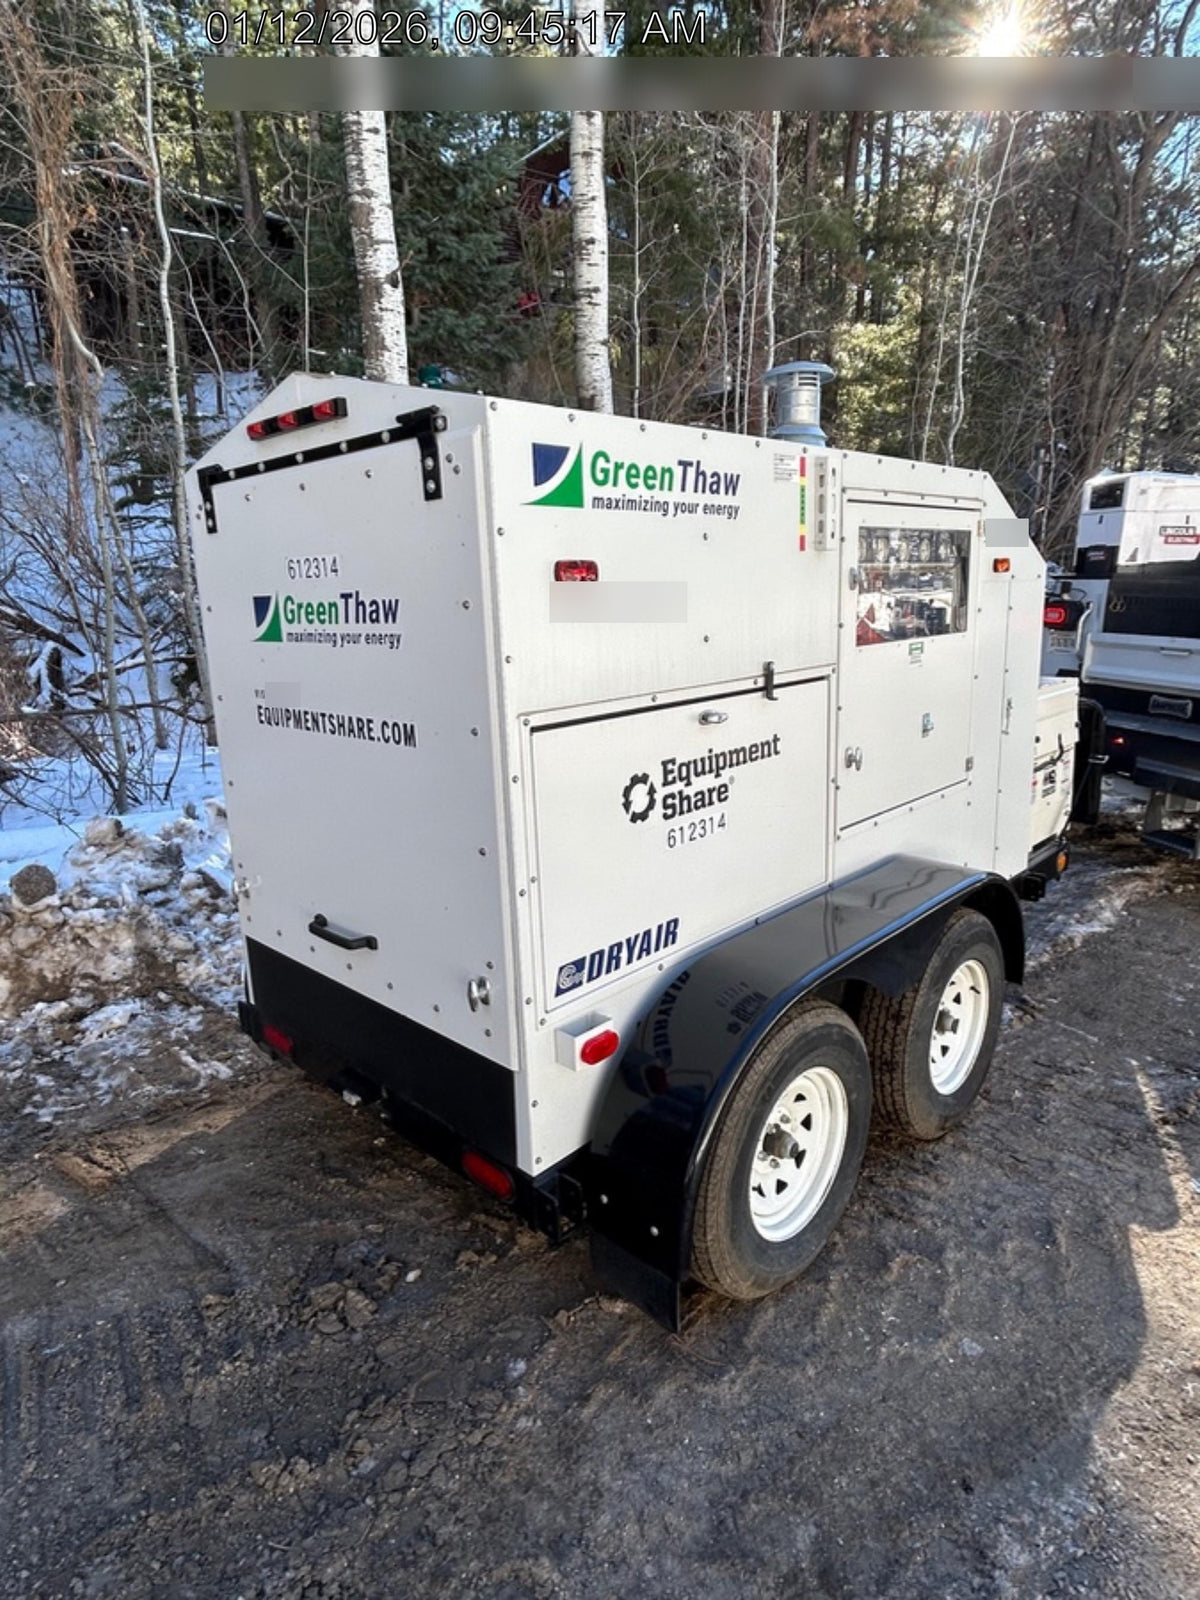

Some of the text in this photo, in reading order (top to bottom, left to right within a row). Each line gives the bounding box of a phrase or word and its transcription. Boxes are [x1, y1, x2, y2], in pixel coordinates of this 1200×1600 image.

[589, 449, 742, 497] GreenThaw
[591, 494, 740, 520] maximizing your energy
[287, 556, 339, 580] 612314
[283, 590, 400, 625] GreenThaw
[286, 627, 402, 650] maximizing your energy
[256, 704, 417, 748] EQUIPMENTSHARE.COM
[660, 733, 782, 788] Equipment
[666, 812, 727, 849] 612314
[585, 917, 680, 984] DRYAIR
